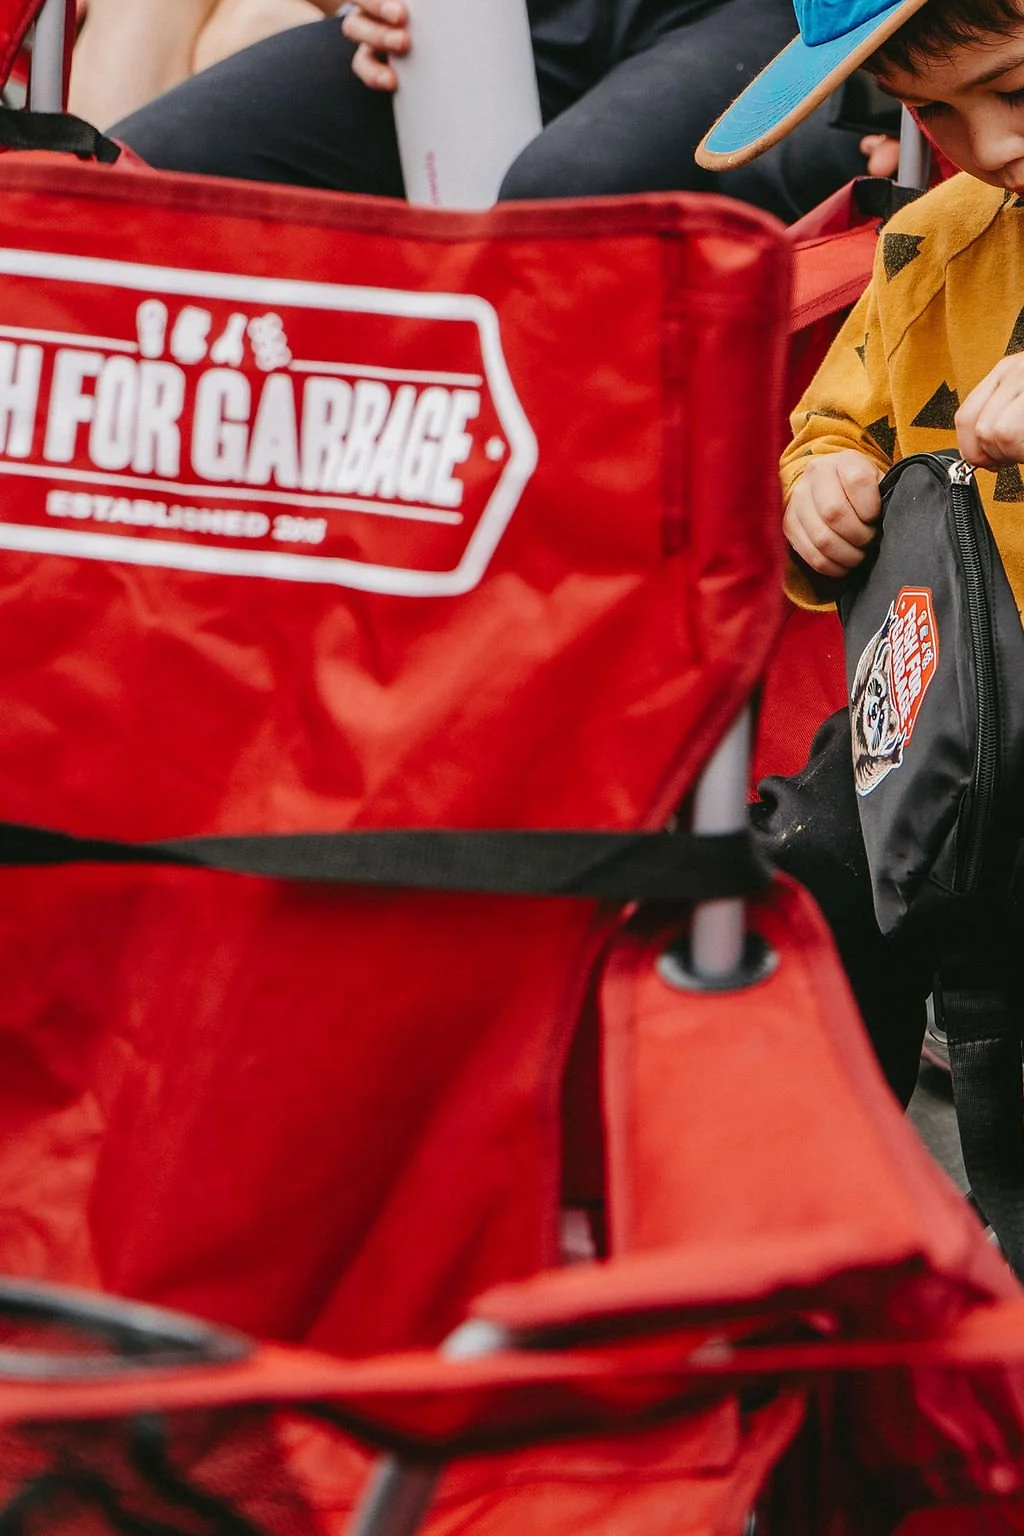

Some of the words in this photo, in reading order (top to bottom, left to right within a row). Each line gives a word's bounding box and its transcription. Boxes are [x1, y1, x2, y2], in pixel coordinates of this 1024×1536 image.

[43, 348, 185, 479] FOR
[191, 367, 480, 508] GARBAGE
[46, 490, 270, 538] ESTABLISHED
[904, 602, 920, 659] FISH
[892, 618, 911, 728] GARBAGE
[906, 653, 921, 704] FOR
